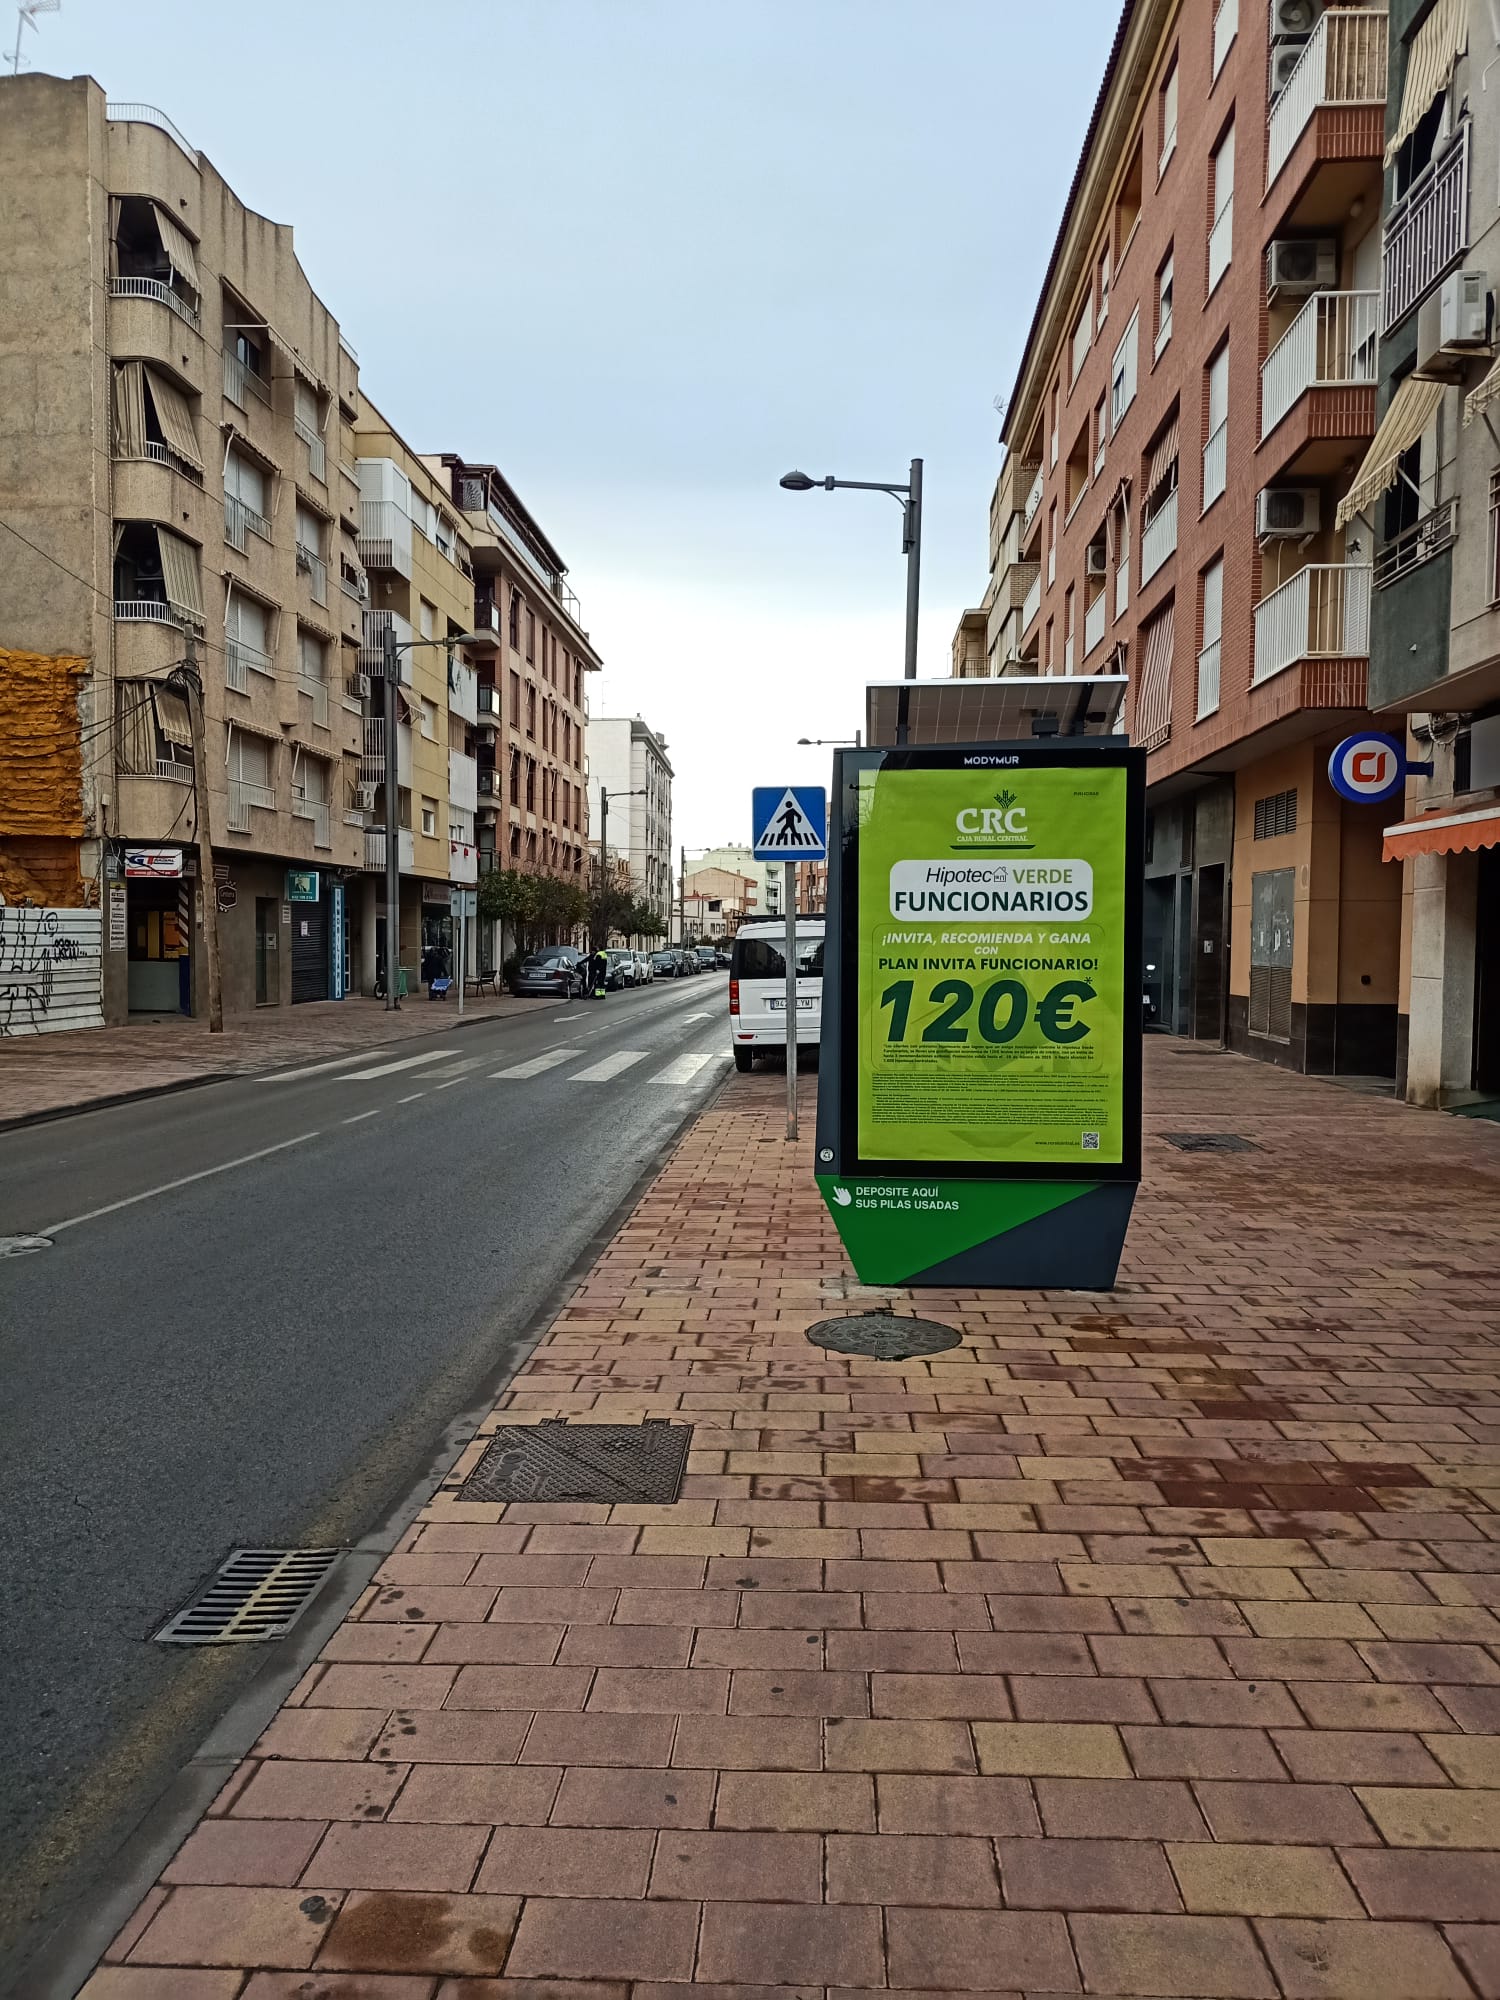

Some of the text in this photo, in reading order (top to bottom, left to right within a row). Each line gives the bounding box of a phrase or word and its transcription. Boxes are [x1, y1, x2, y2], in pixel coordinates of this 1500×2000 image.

[963, 756, 1020, 765] MODYMUR
[955, 807, 1029, 834] CRC
[1013, 869, 1073, 884] VERDE
[894, 890, 1089, 912] FUNCIONARIOS
[882, 932, 1092, 946] ¡INVITA, RECOMIENDA Y GANA
[973, 946, 999, 955] CON
[878, 958, 1099, 971] PLAN INVITA FUNCIONARIO!
[855, 1185, 939, 1198] DEPOSITE AQUÍ
[855, 1199, 960, 1210] SUS PILAS USADAS
